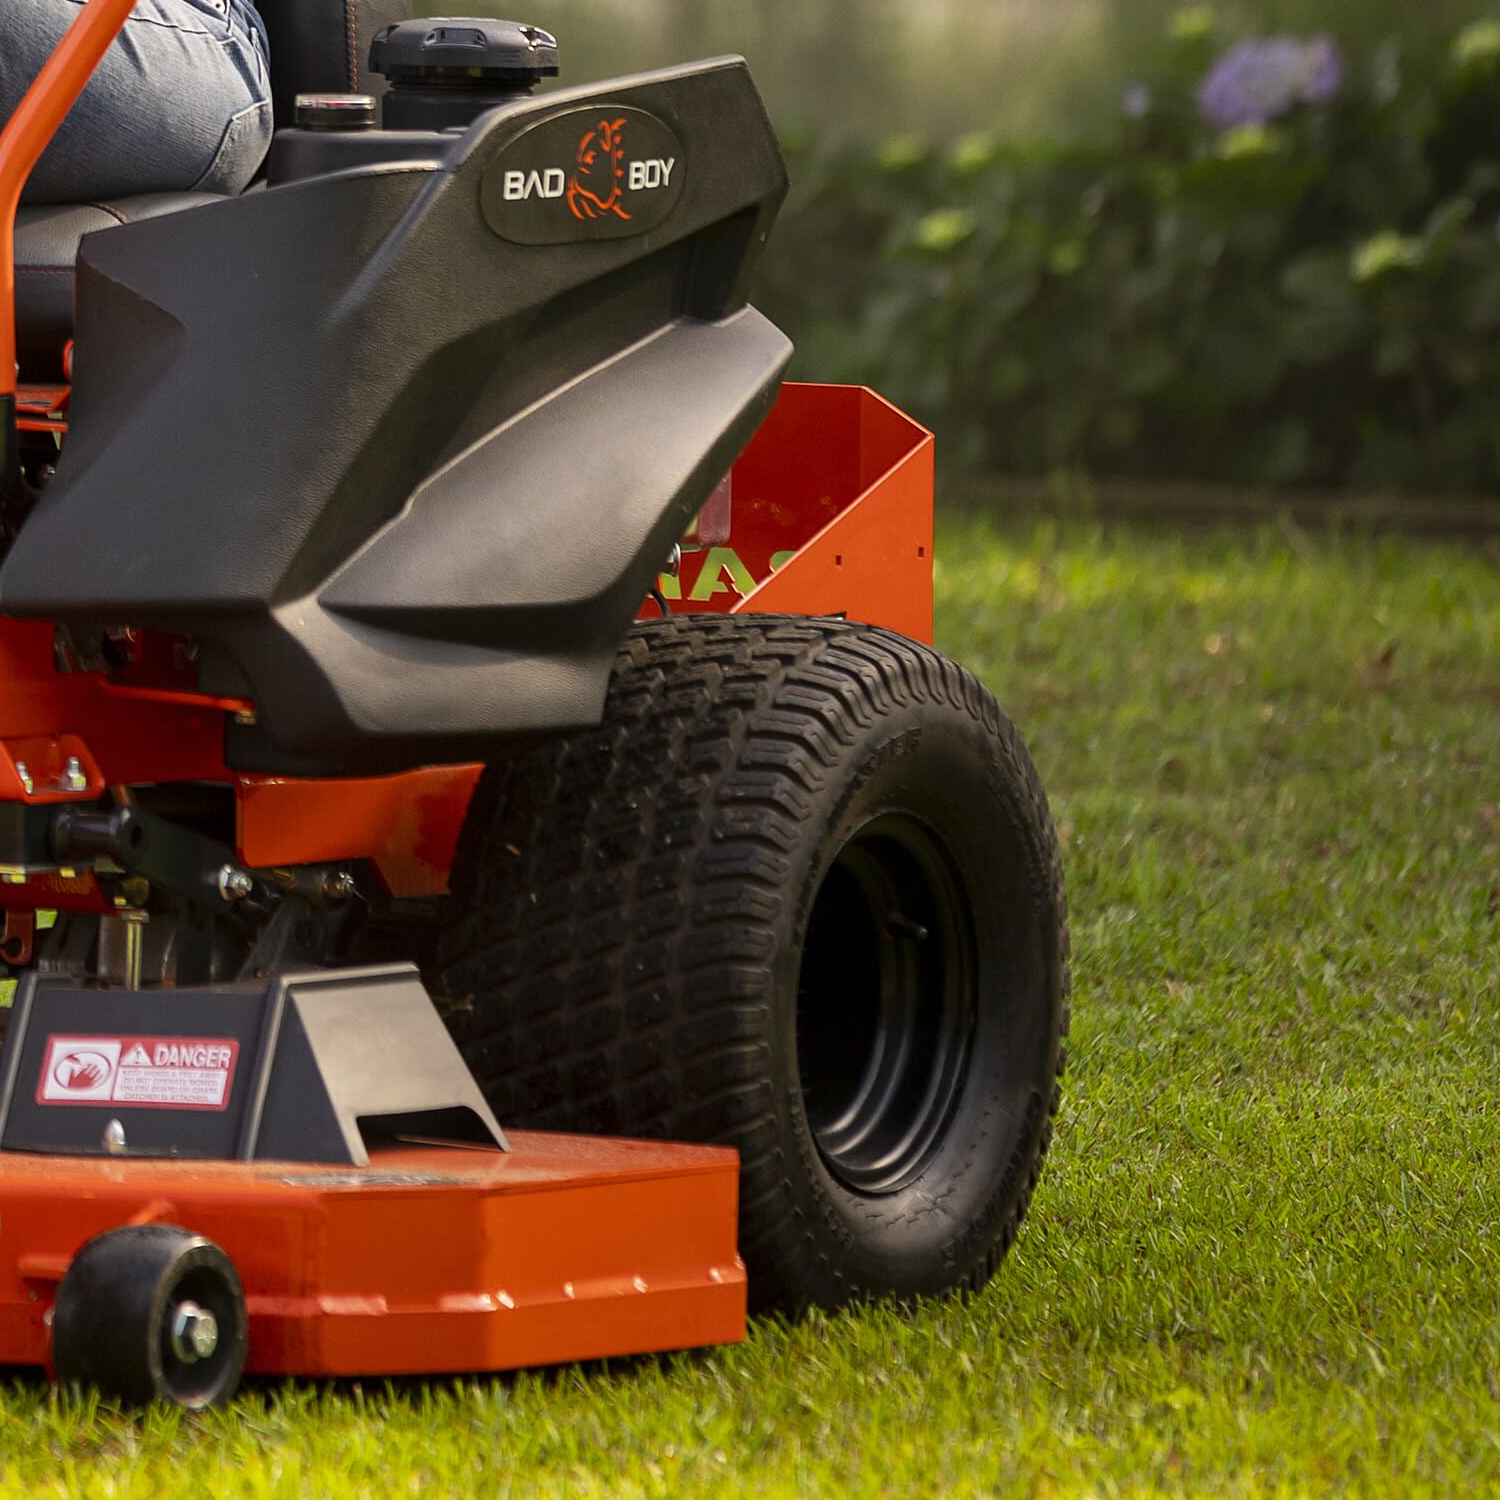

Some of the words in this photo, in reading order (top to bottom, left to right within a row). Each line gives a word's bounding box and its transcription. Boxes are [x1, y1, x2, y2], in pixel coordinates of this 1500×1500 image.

[503, 168, 565, 201] BAD
[628, 157, 675, 190] BOY
[153, 1043, 231, 1069] DANGER
